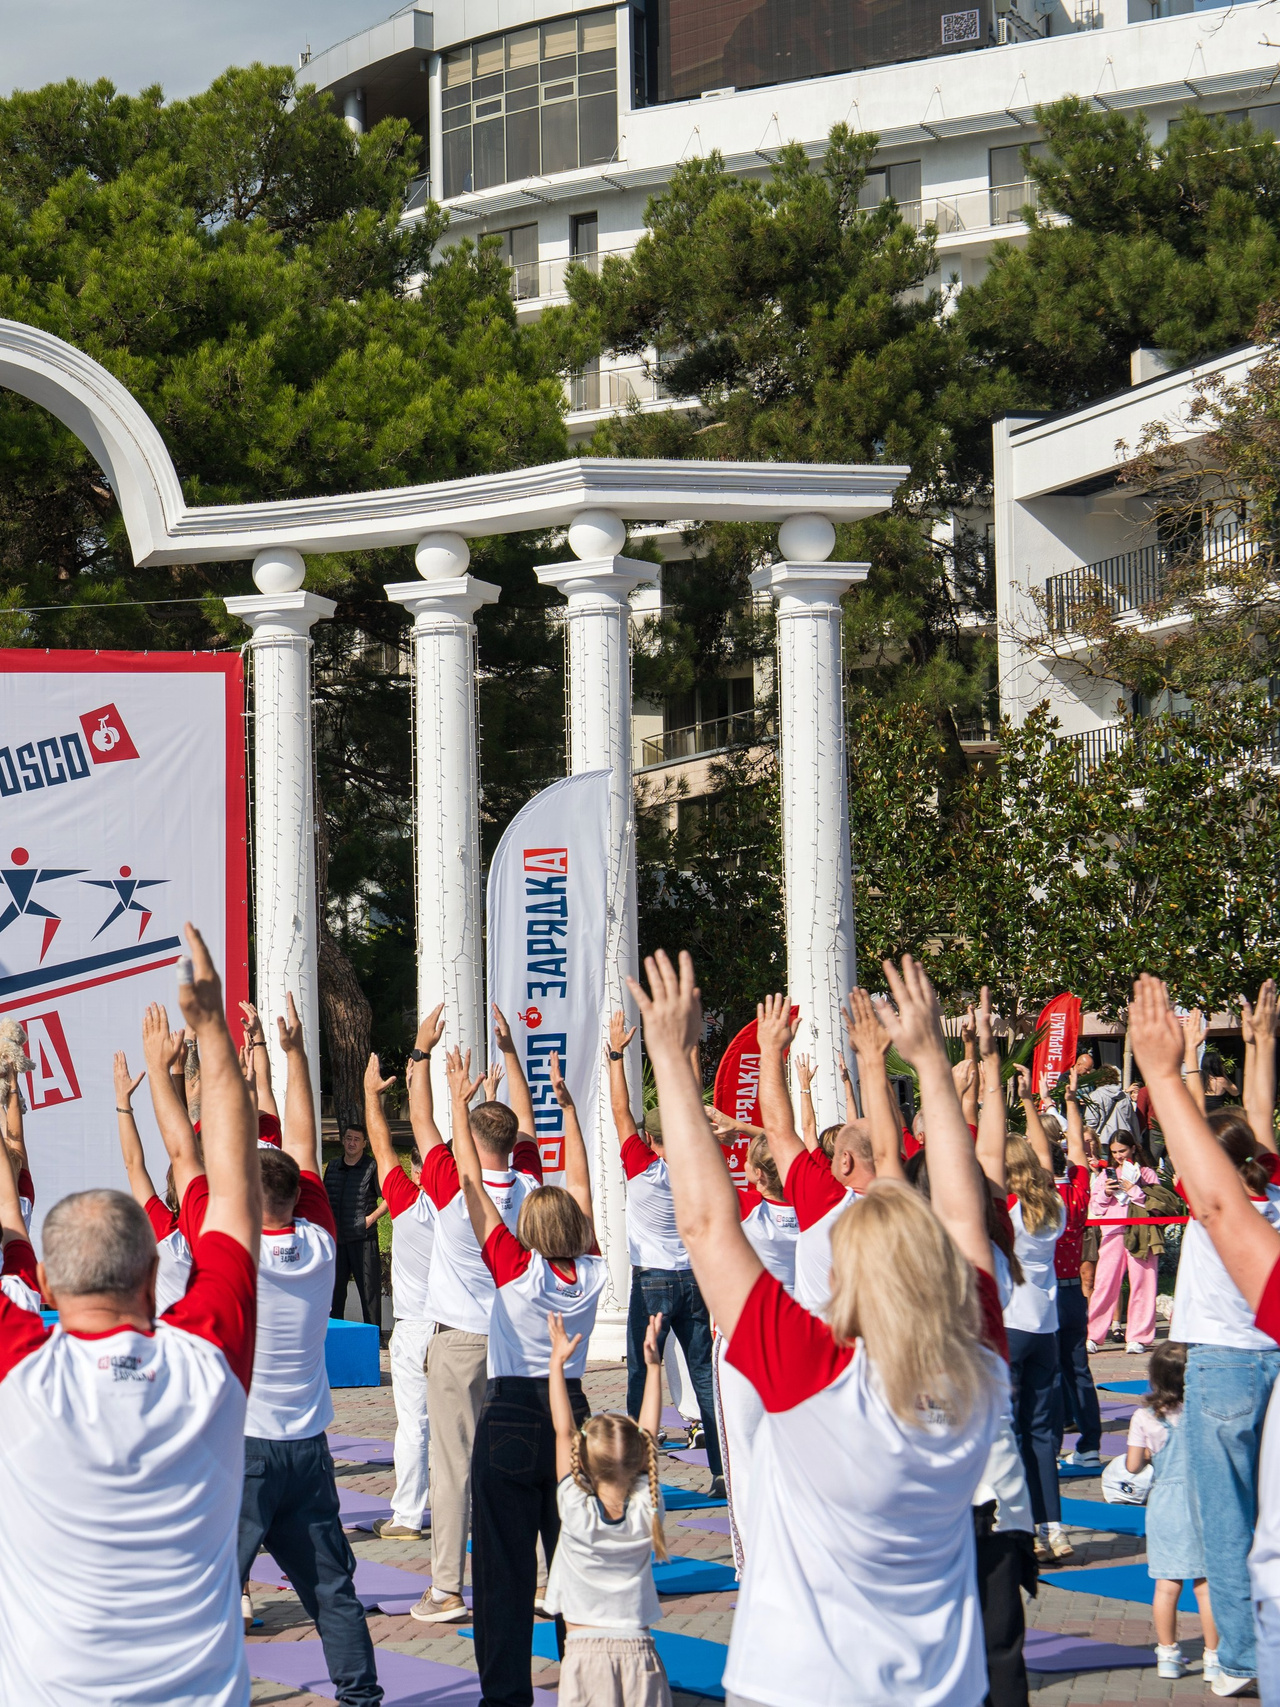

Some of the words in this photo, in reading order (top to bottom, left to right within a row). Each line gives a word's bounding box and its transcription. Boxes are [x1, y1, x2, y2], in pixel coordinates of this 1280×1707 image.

[523, 848, 568, 1000] ЗАРЯДКА
[1047, 1013, 1066, 1062] ЗАРЯДКА
[731, 1053, 761, 1150] ЗРЯДКА
